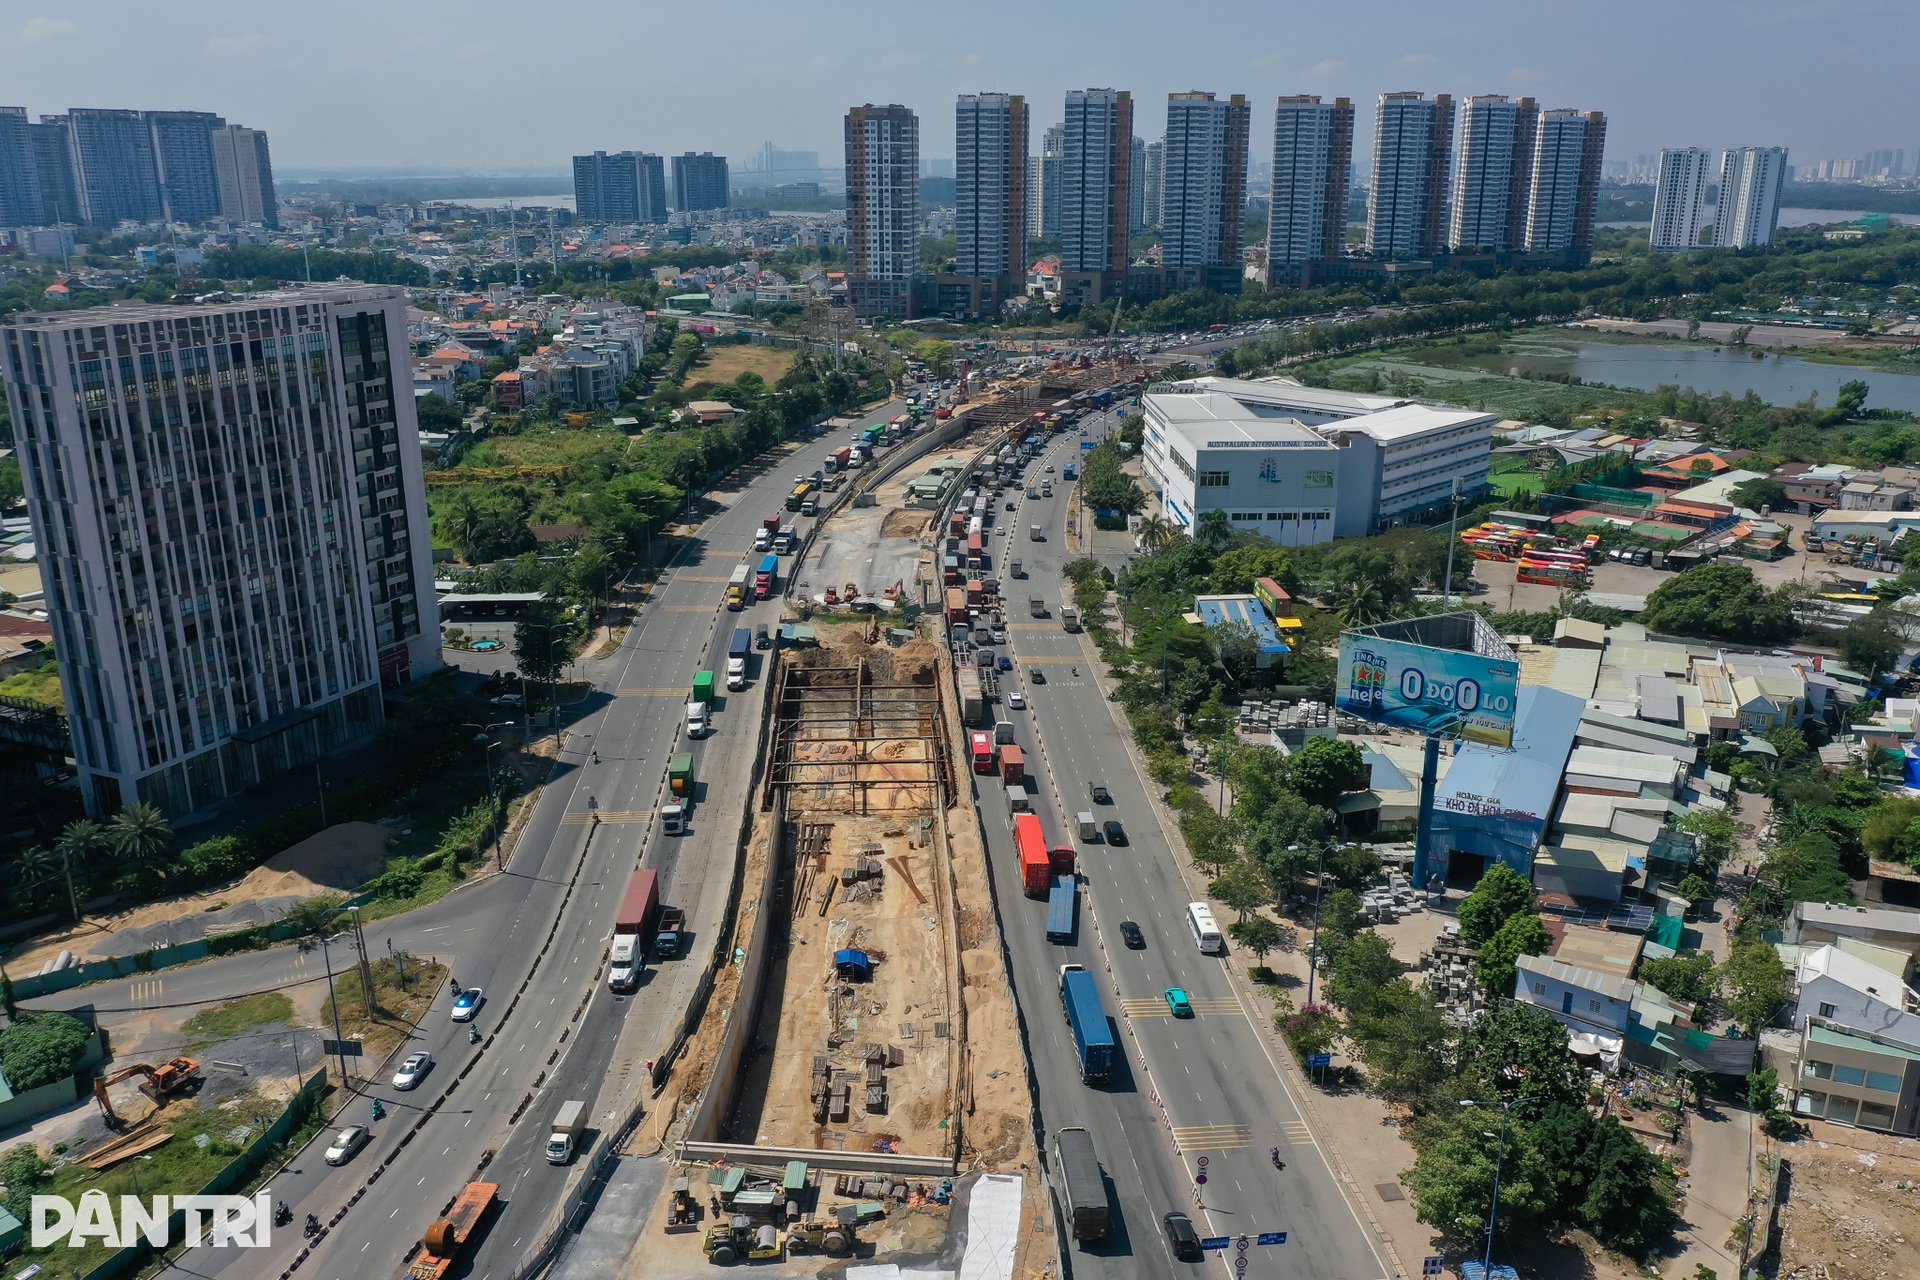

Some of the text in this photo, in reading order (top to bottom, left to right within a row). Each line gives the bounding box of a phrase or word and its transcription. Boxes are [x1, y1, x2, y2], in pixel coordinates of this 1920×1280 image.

[1304, 440, 1328, 448] SCHOOL
[1426, 683, 1454, 704] ĐỘ
[1482, 692, 1509, 712] LO
[1445, 798, 1465, 812] KHO
